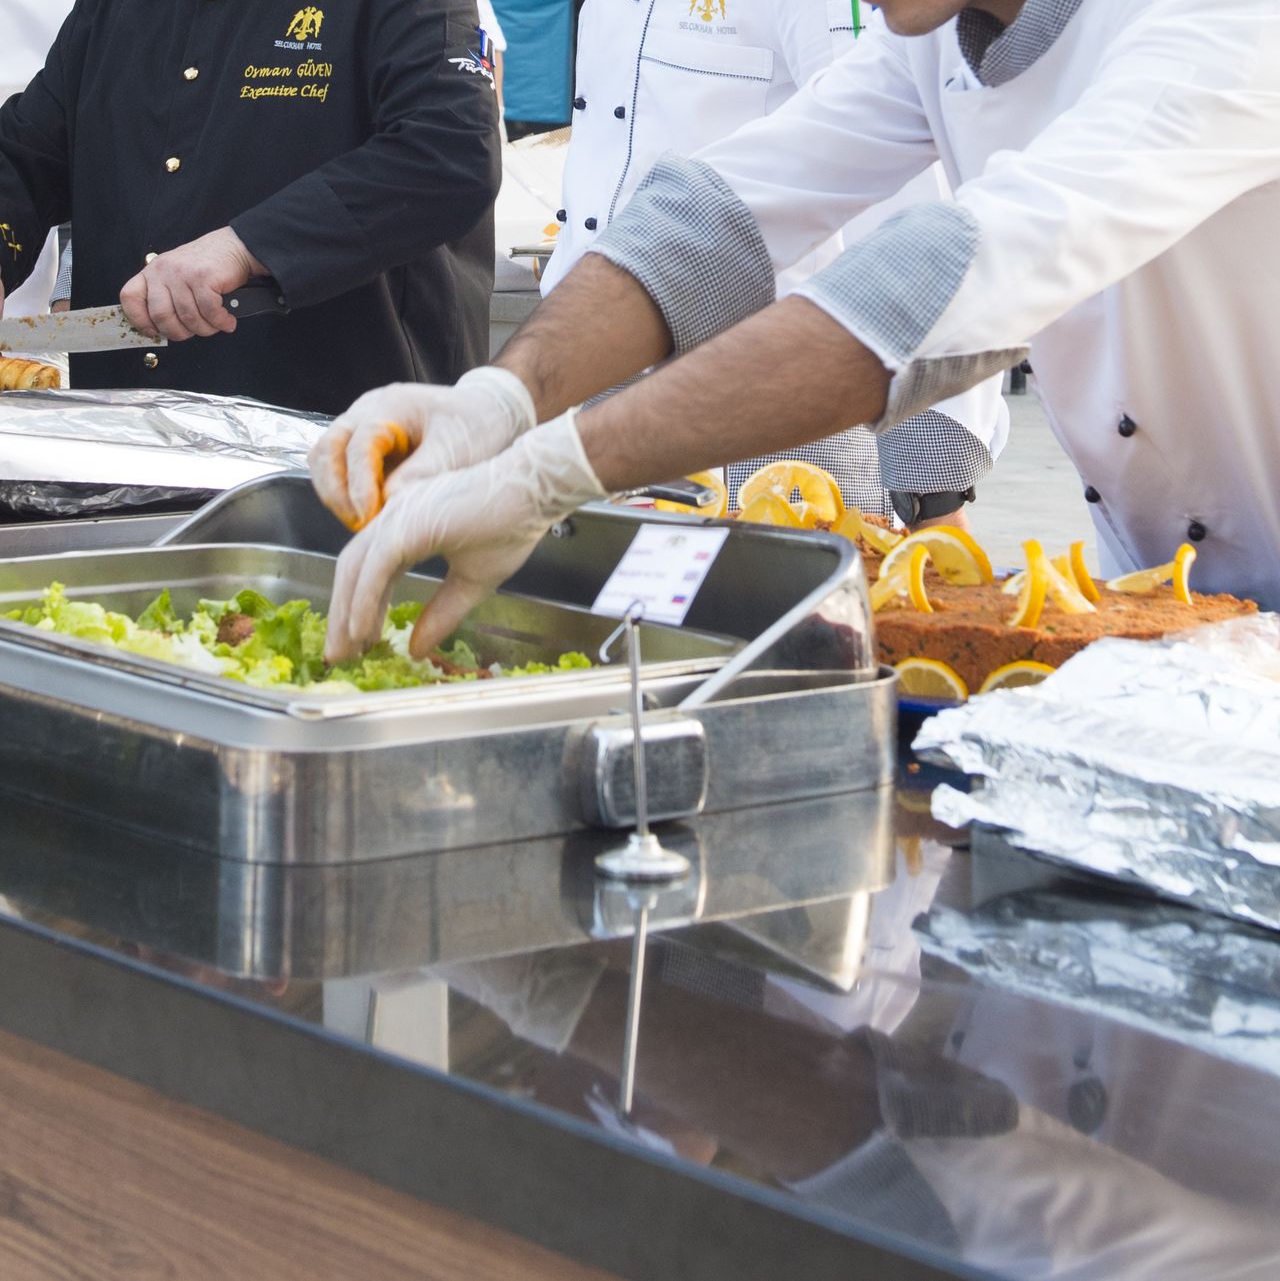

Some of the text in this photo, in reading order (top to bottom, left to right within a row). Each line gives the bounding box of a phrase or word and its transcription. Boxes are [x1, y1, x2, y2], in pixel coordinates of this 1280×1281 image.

[717, 26, 737, 35] HOTEL
[306, 42, 322, 50] HOTEL
[244, 59, 332, 78] Osman GÜVEN
[240, 83, 329, 102] Executive Chef
